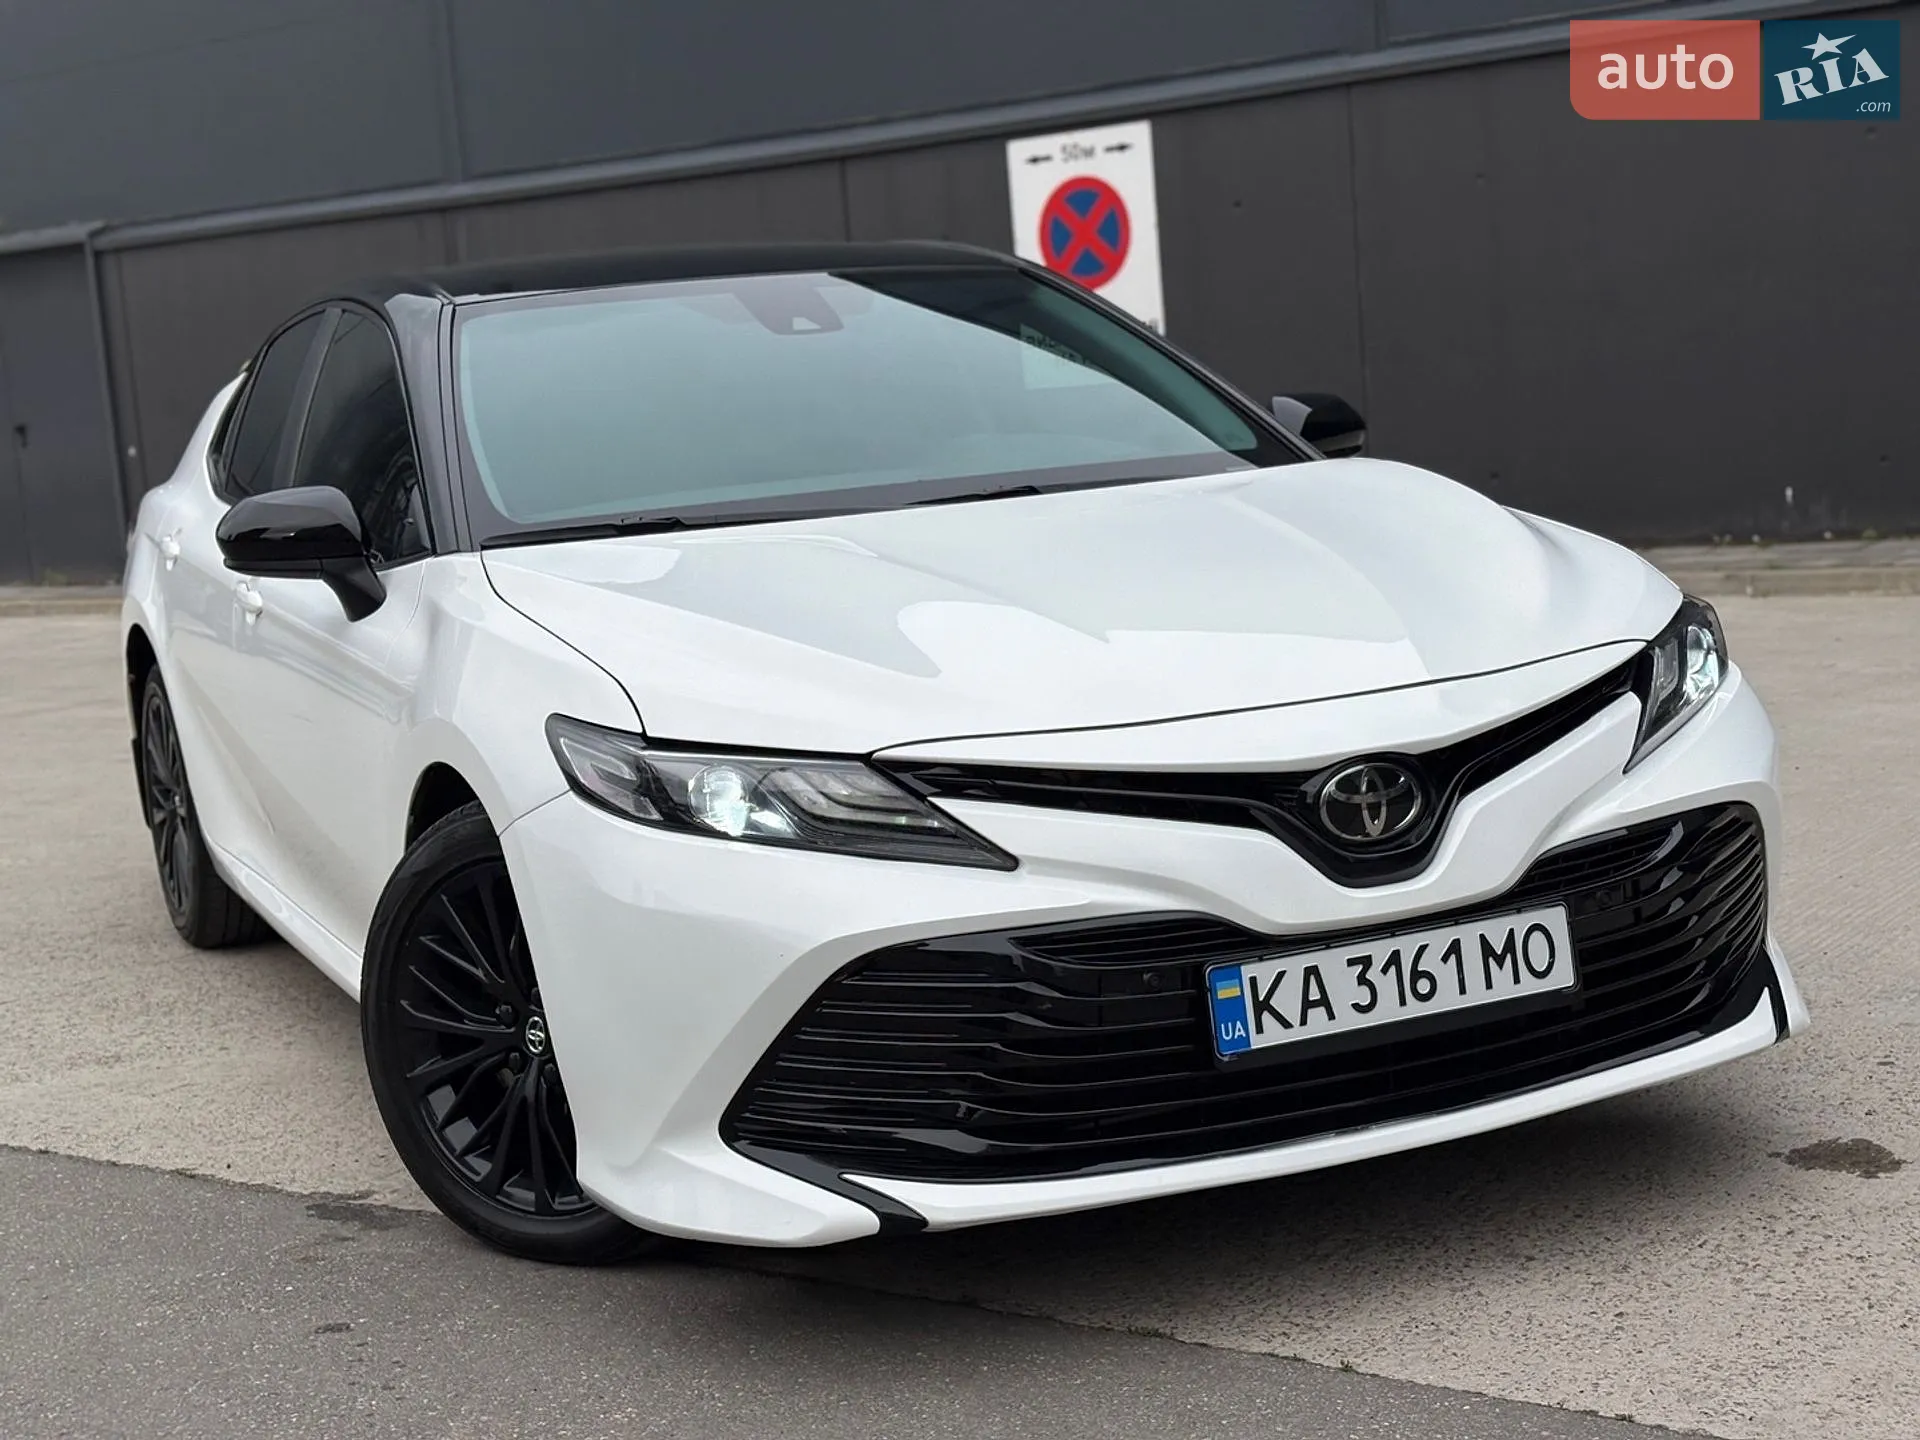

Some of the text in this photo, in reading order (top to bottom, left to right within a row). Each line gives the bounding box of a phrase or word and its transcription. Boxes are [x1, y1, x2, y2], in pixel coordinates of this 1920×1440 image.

[1248, 922, 1556, 1035] KA 3161 MO
[1221, 1022, 1247, 1041] UA
